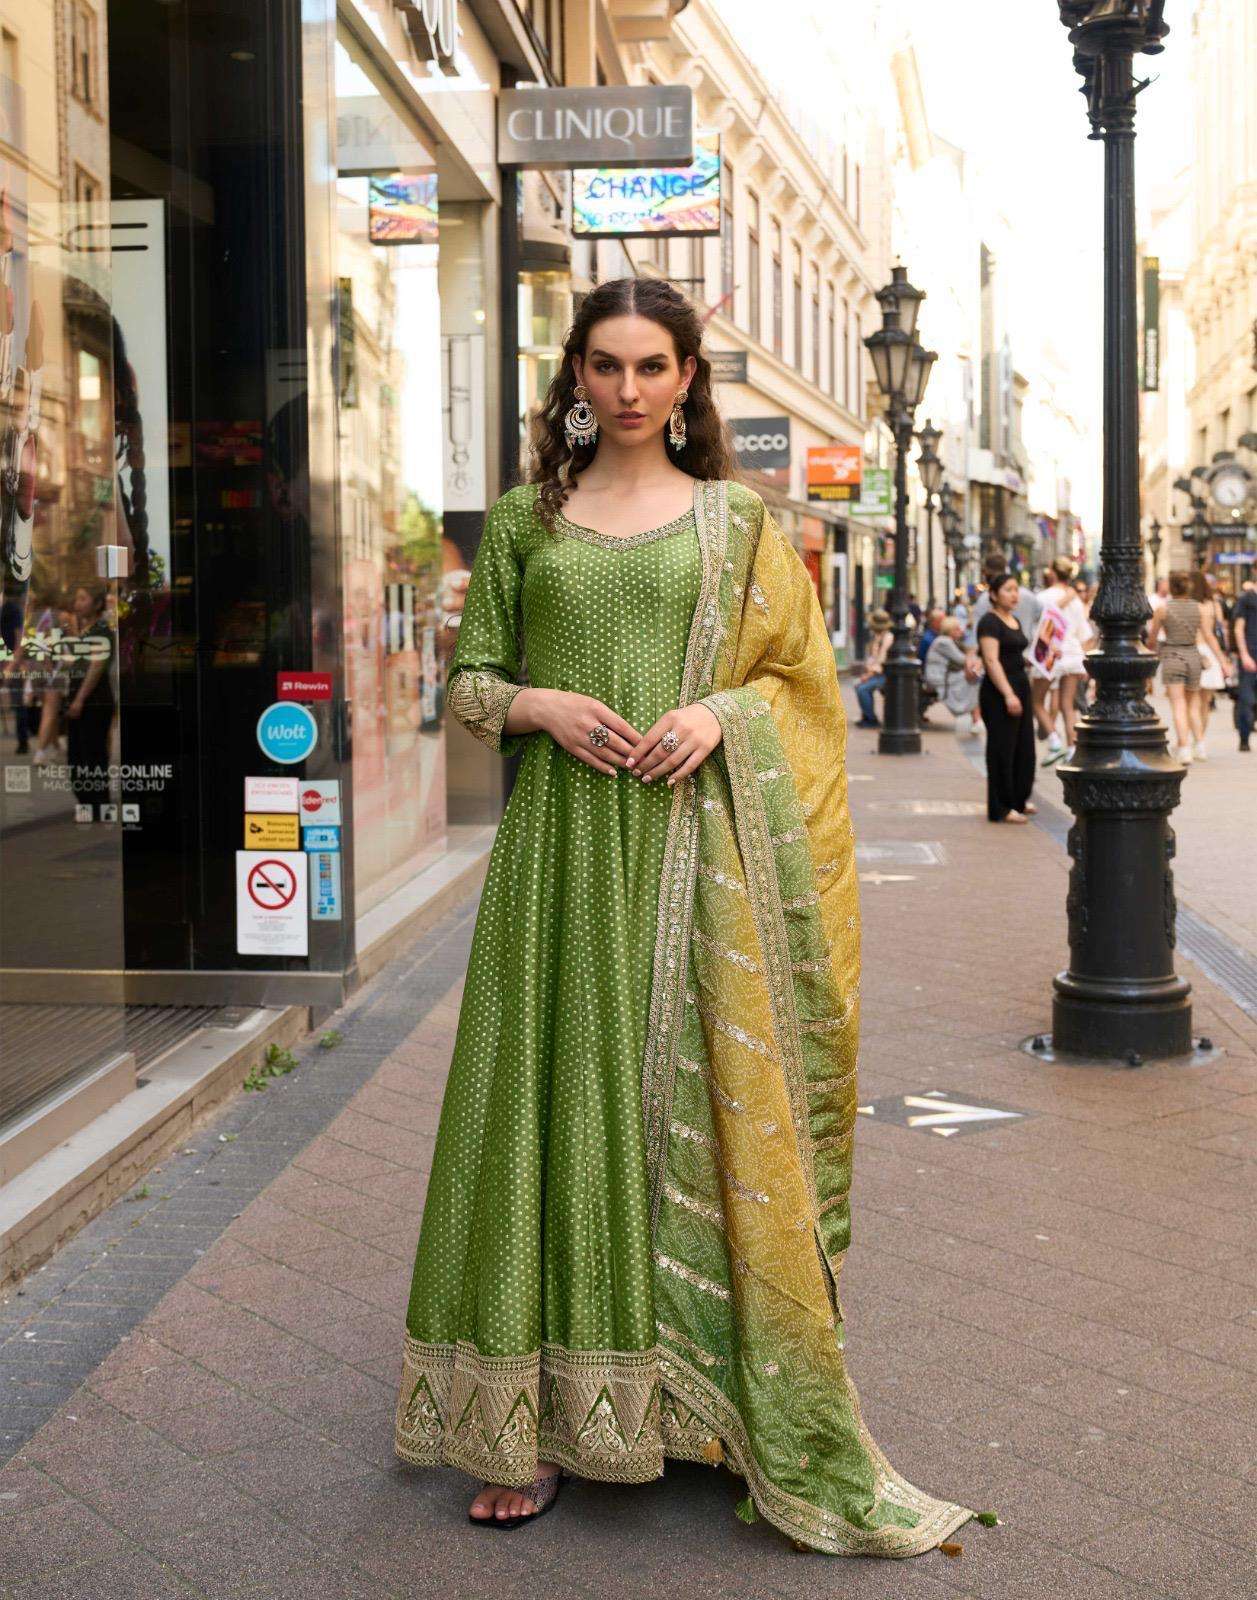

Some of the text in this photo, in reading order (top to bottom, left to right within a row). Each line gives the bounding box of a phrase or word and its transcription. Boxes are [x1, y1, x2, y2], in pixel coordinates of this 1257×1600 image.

[506, 106, 685, 144] CLINIQUE
[586, 175, 707, 201] CHANGE
[268, 724, 306, 740] Wolt
[38, 765, 75, 778] MEET
[120, 764, 173, 778] ONLINE
[43, 780, 165, 792] MACCOSMEICS.HU
